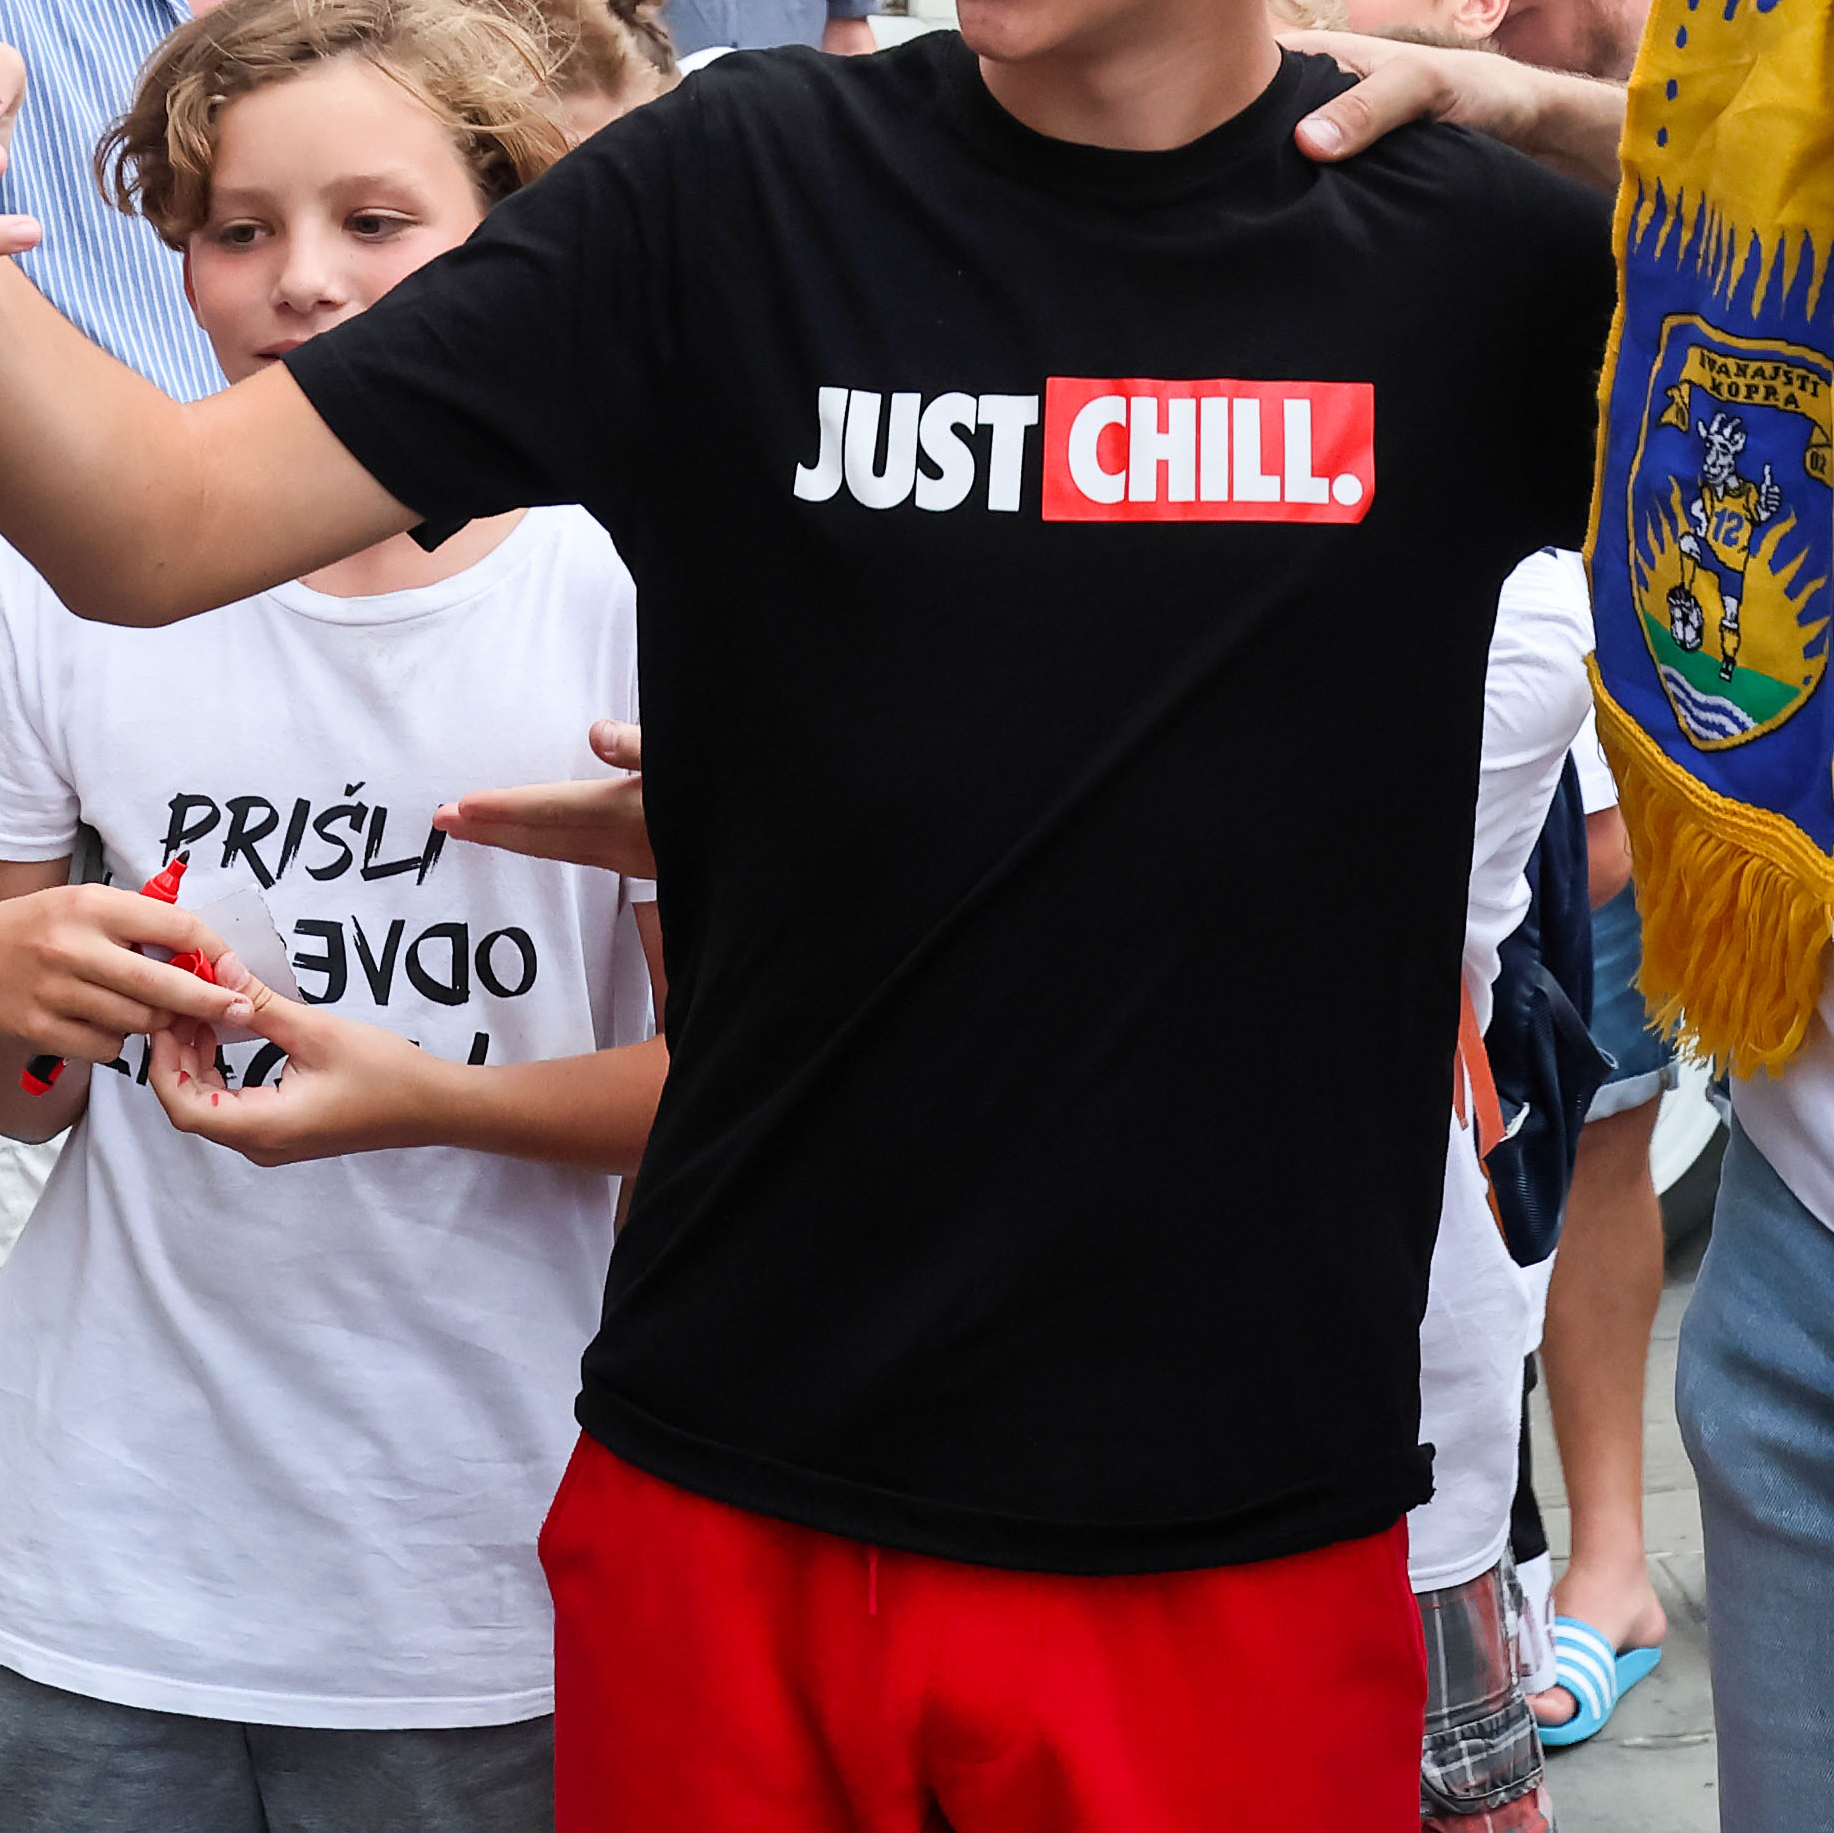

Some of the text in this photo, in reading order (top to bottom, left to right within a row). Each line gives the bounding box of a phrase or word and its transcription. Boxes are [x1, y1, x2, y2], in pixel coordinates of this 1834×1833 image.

[1710, 375, 1801, 409] KOPRA
[792, 385, 1364, 513] JUST CHILL.
[1712, 508, 1744, 548] 12
[159, 781, 448, 890] PRIŠLI
